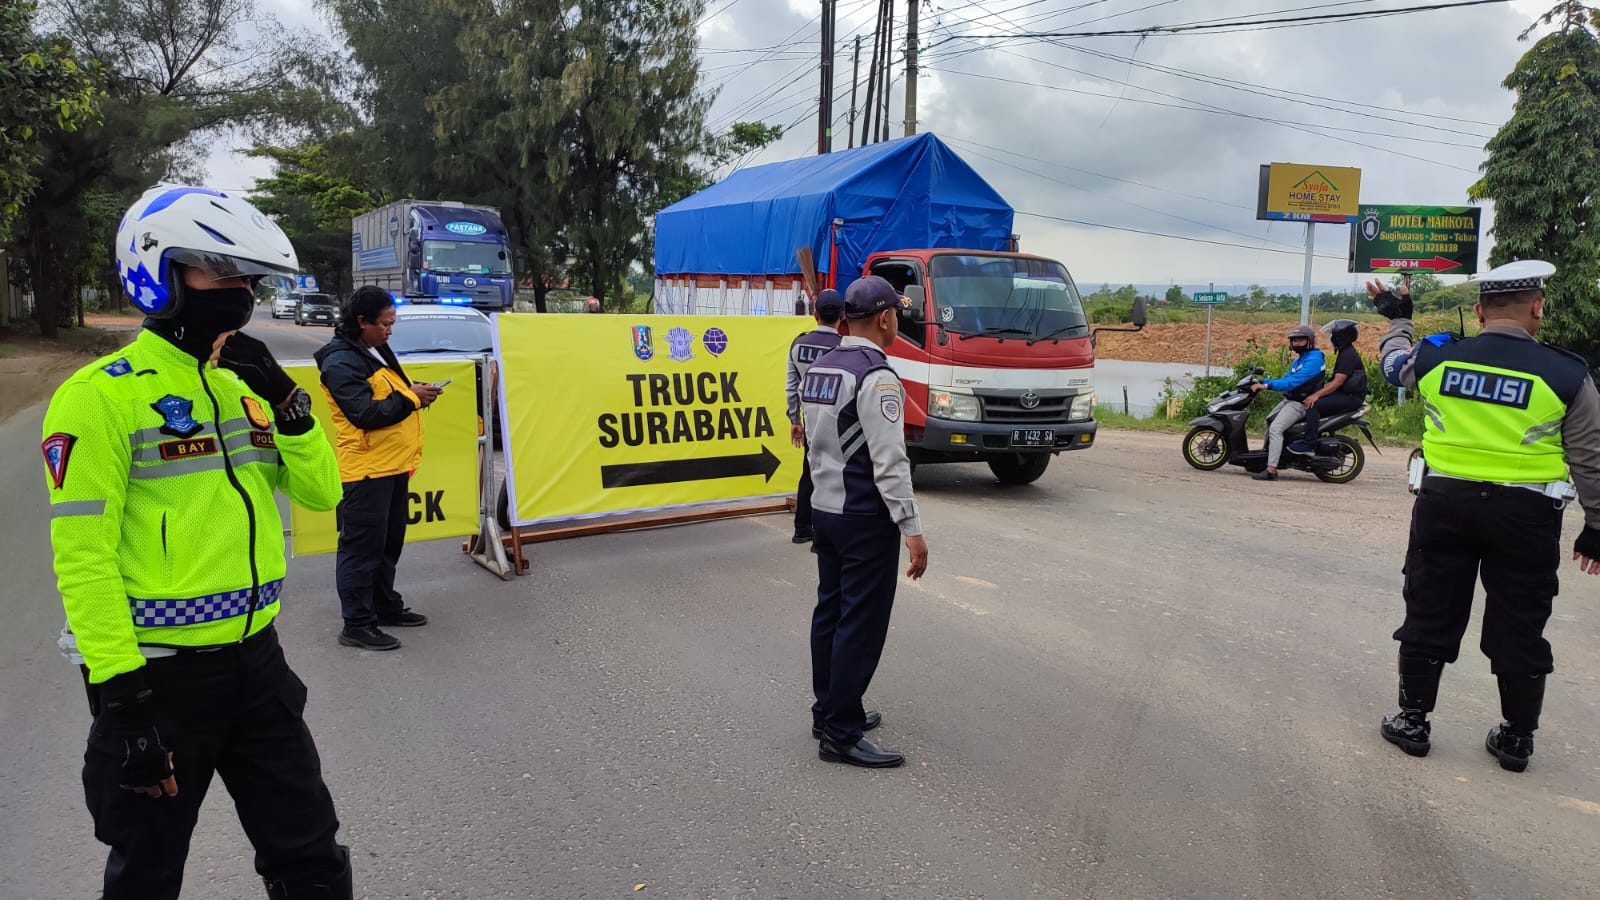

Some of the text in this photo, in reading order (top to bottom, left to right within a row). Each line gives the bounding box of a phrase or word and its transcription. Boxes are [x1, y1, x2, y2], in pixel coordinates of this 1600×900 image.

[1289, 192, 1341, 203] HOME STAY
[1390, 215, 1475, 229] HOTEL MAHKOTA
[1455, 233, 1477, 242] Tuban
[800, 347, 824, 361] LLA
[626, 371, 742, 407] TRUCK
[804, 375, 839, 400] LLAJ
[1443, 369, 1529, 405] POLISI
[597, 406, 775, 448] SURABAYA
[255, 434, 274, 444] POL
[1014, 430, 1053, 441] R 1432 SA
[177, 442, 206, 454] BAY
